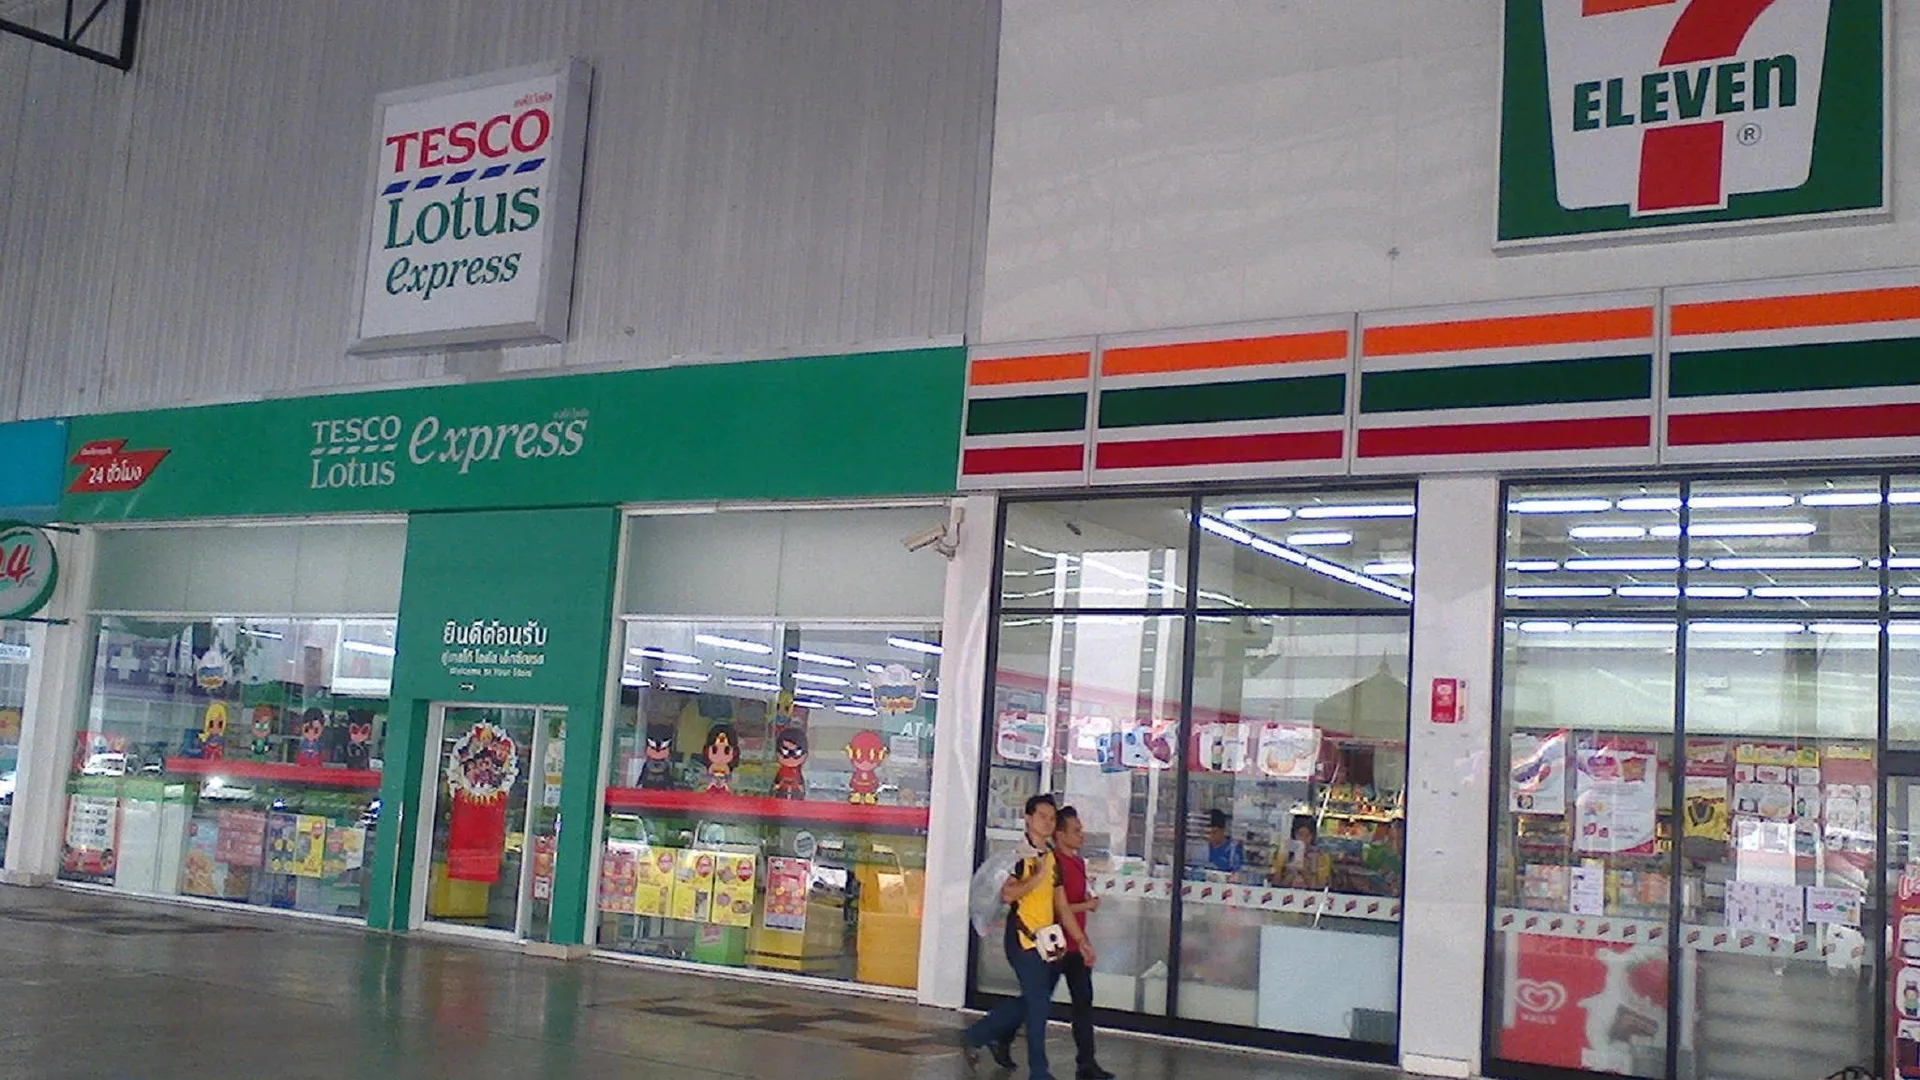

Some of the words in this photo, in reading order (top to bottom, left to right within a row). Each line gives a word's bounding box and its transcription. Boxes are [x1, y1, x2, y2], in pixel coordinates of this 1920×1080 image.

[386, 108, 550, 173] TESCO
[384, 186, 541, 250] Lotus
[386, 252, 523, 301] express
[311, 414, 402, 444] TESCO
[408, 416, 588, 475] express
[89, 466, 104, 484] 24
[310, 457, 396, 489] Lotus
[443, 619, 548, 646] ยินดีต้อนรับ
